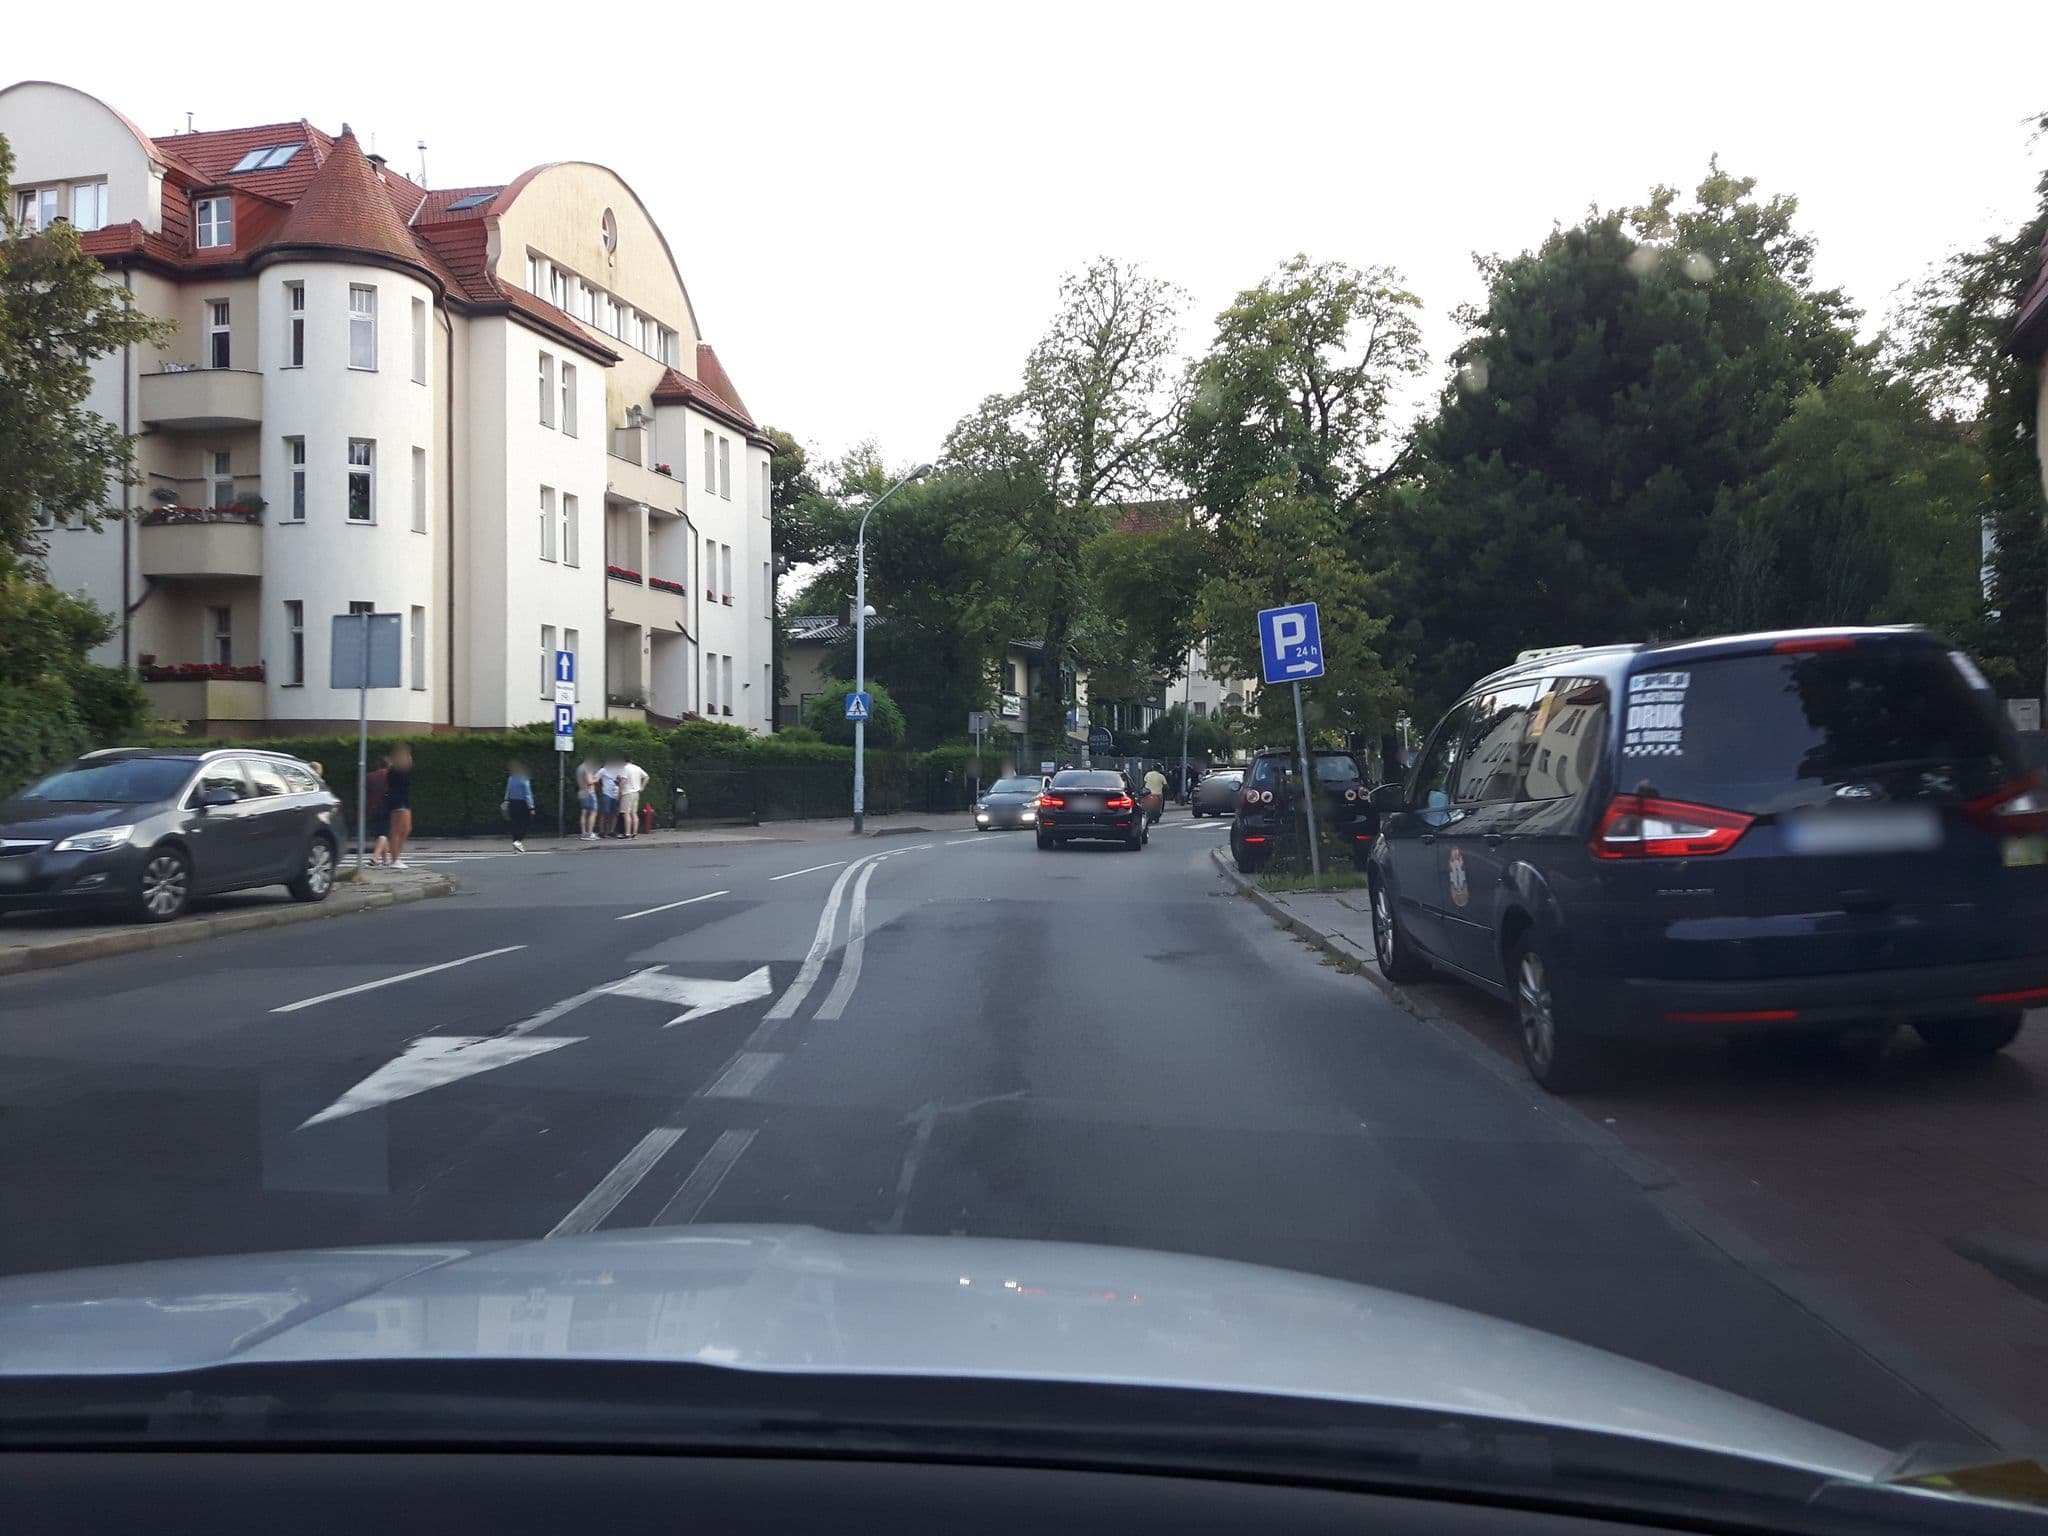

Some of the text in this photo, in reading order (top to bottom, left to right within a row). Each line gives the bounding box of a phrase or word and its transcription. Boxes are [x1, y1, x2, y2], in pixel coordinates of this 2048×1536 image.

[1272, 612, 1306, 661] P
[1295, 645, 1318, 657] 24 h
[558, 708, 570, 732] P
